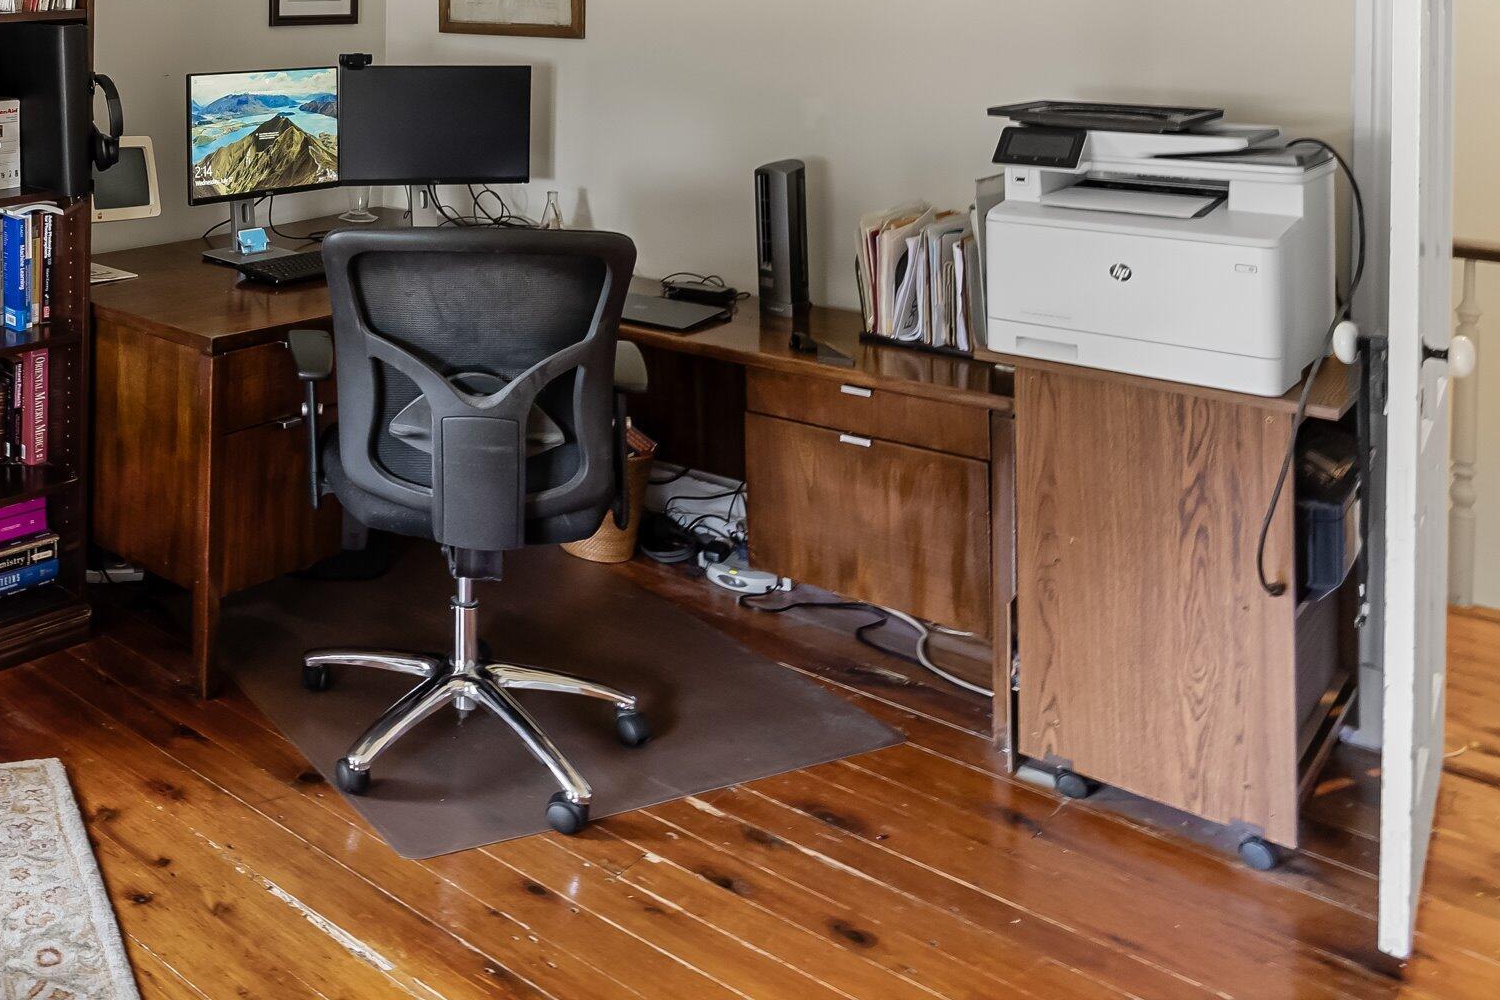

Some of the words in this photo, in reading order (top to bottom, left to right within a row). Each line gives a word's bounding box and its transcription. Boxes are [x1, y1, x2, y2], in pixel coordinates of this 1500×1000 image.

[195, 165, 213, 178] 2:14
[1110, 262, 1132, 282] hp
[35, 356, 45, 391] ORIENTAL
[35, 391, 45, 424] MATERIA
[35, 424, 45, 455] MEDICA
